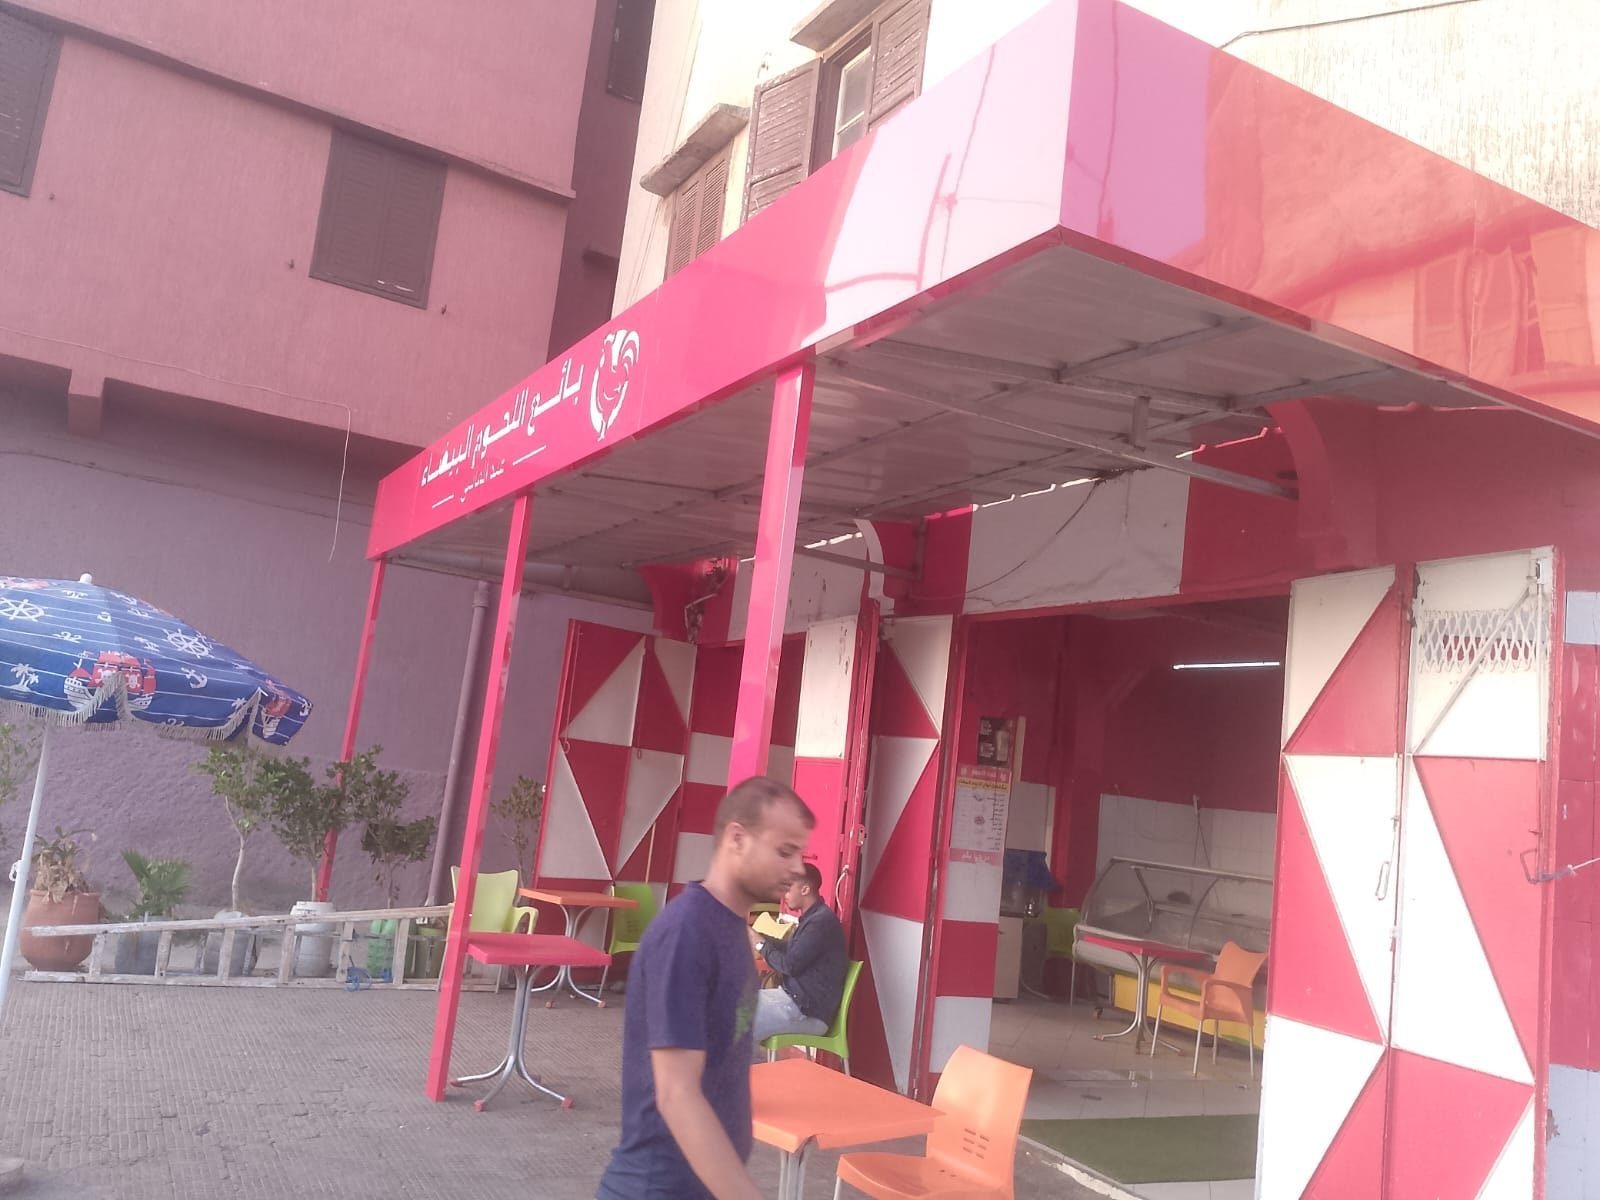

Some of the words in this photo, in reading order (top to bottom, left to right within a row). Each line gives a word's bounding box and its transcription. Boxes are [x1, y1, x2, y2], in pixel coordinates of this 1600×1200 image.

[471, 387, 529, 469] اللحوم
[527, 358, 585, 437] بائع
[421, 423, 475, 486] البيضاء
